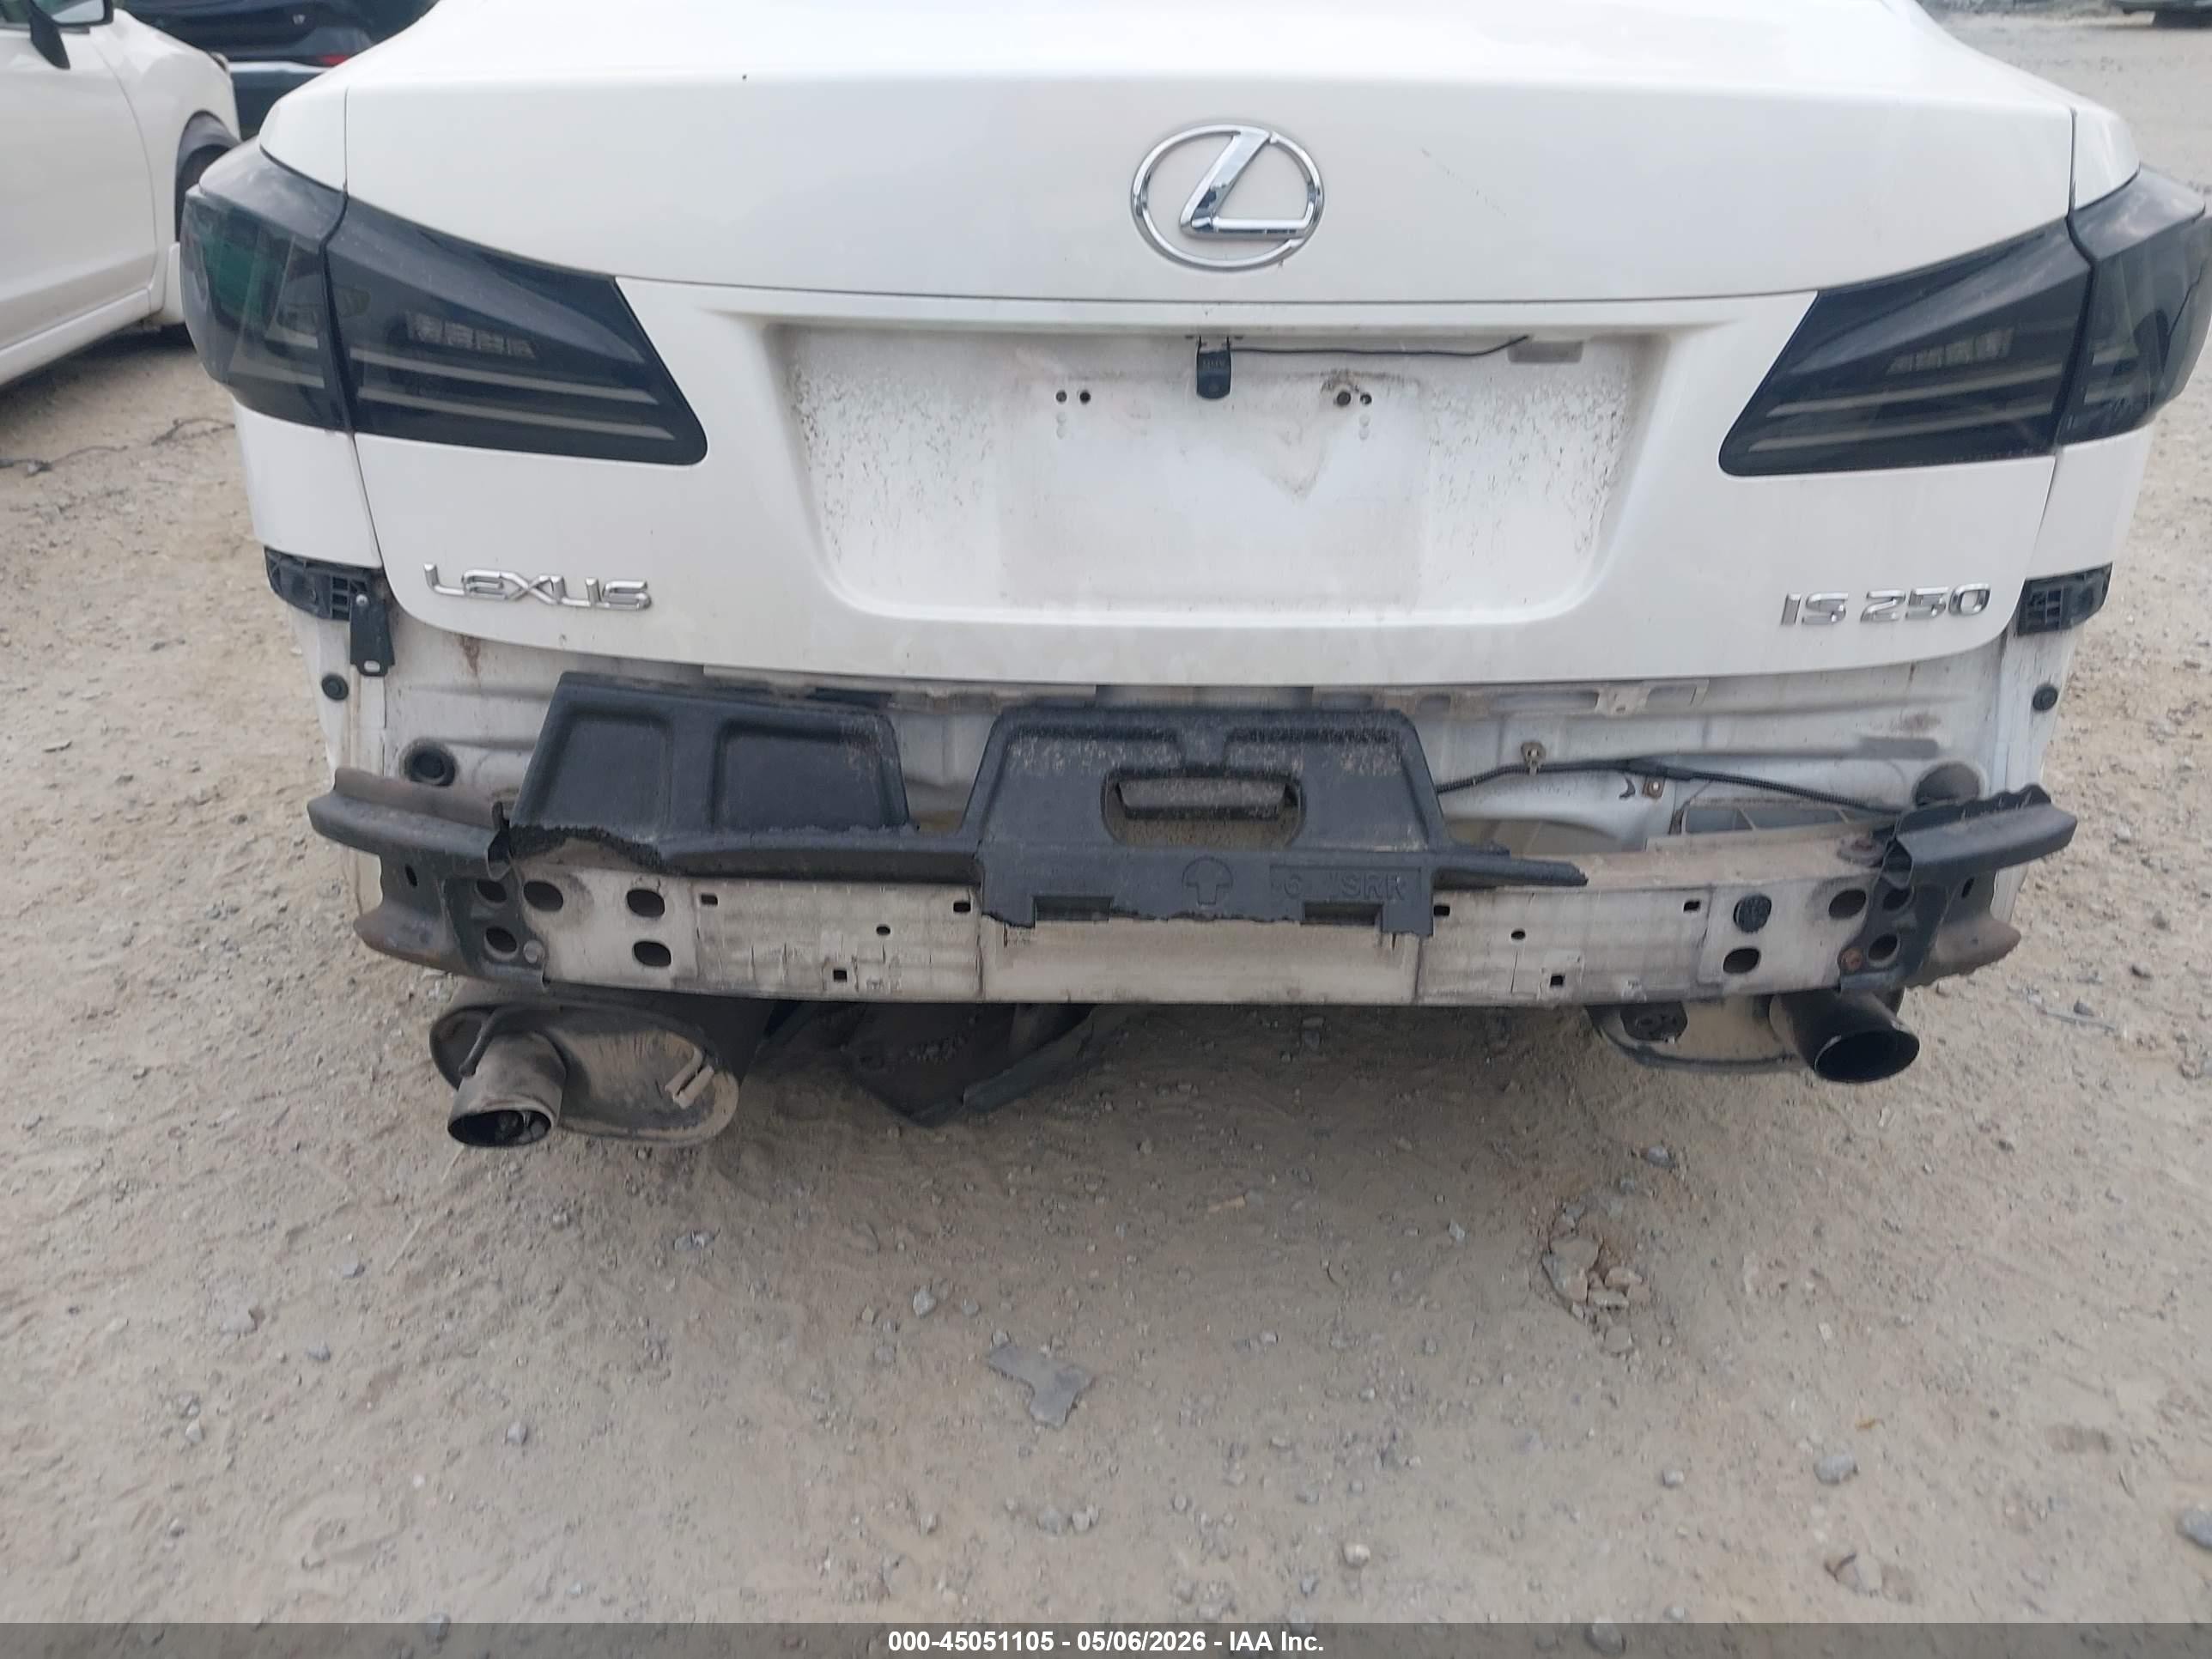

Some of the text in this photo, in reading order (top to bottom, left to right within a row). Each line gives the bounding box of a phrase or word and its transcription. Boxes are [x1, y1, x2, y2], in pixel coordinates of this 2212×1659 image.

[423, 562, 652, 611] LEXUS
[1781, 583, 1991, 625] IS 250
